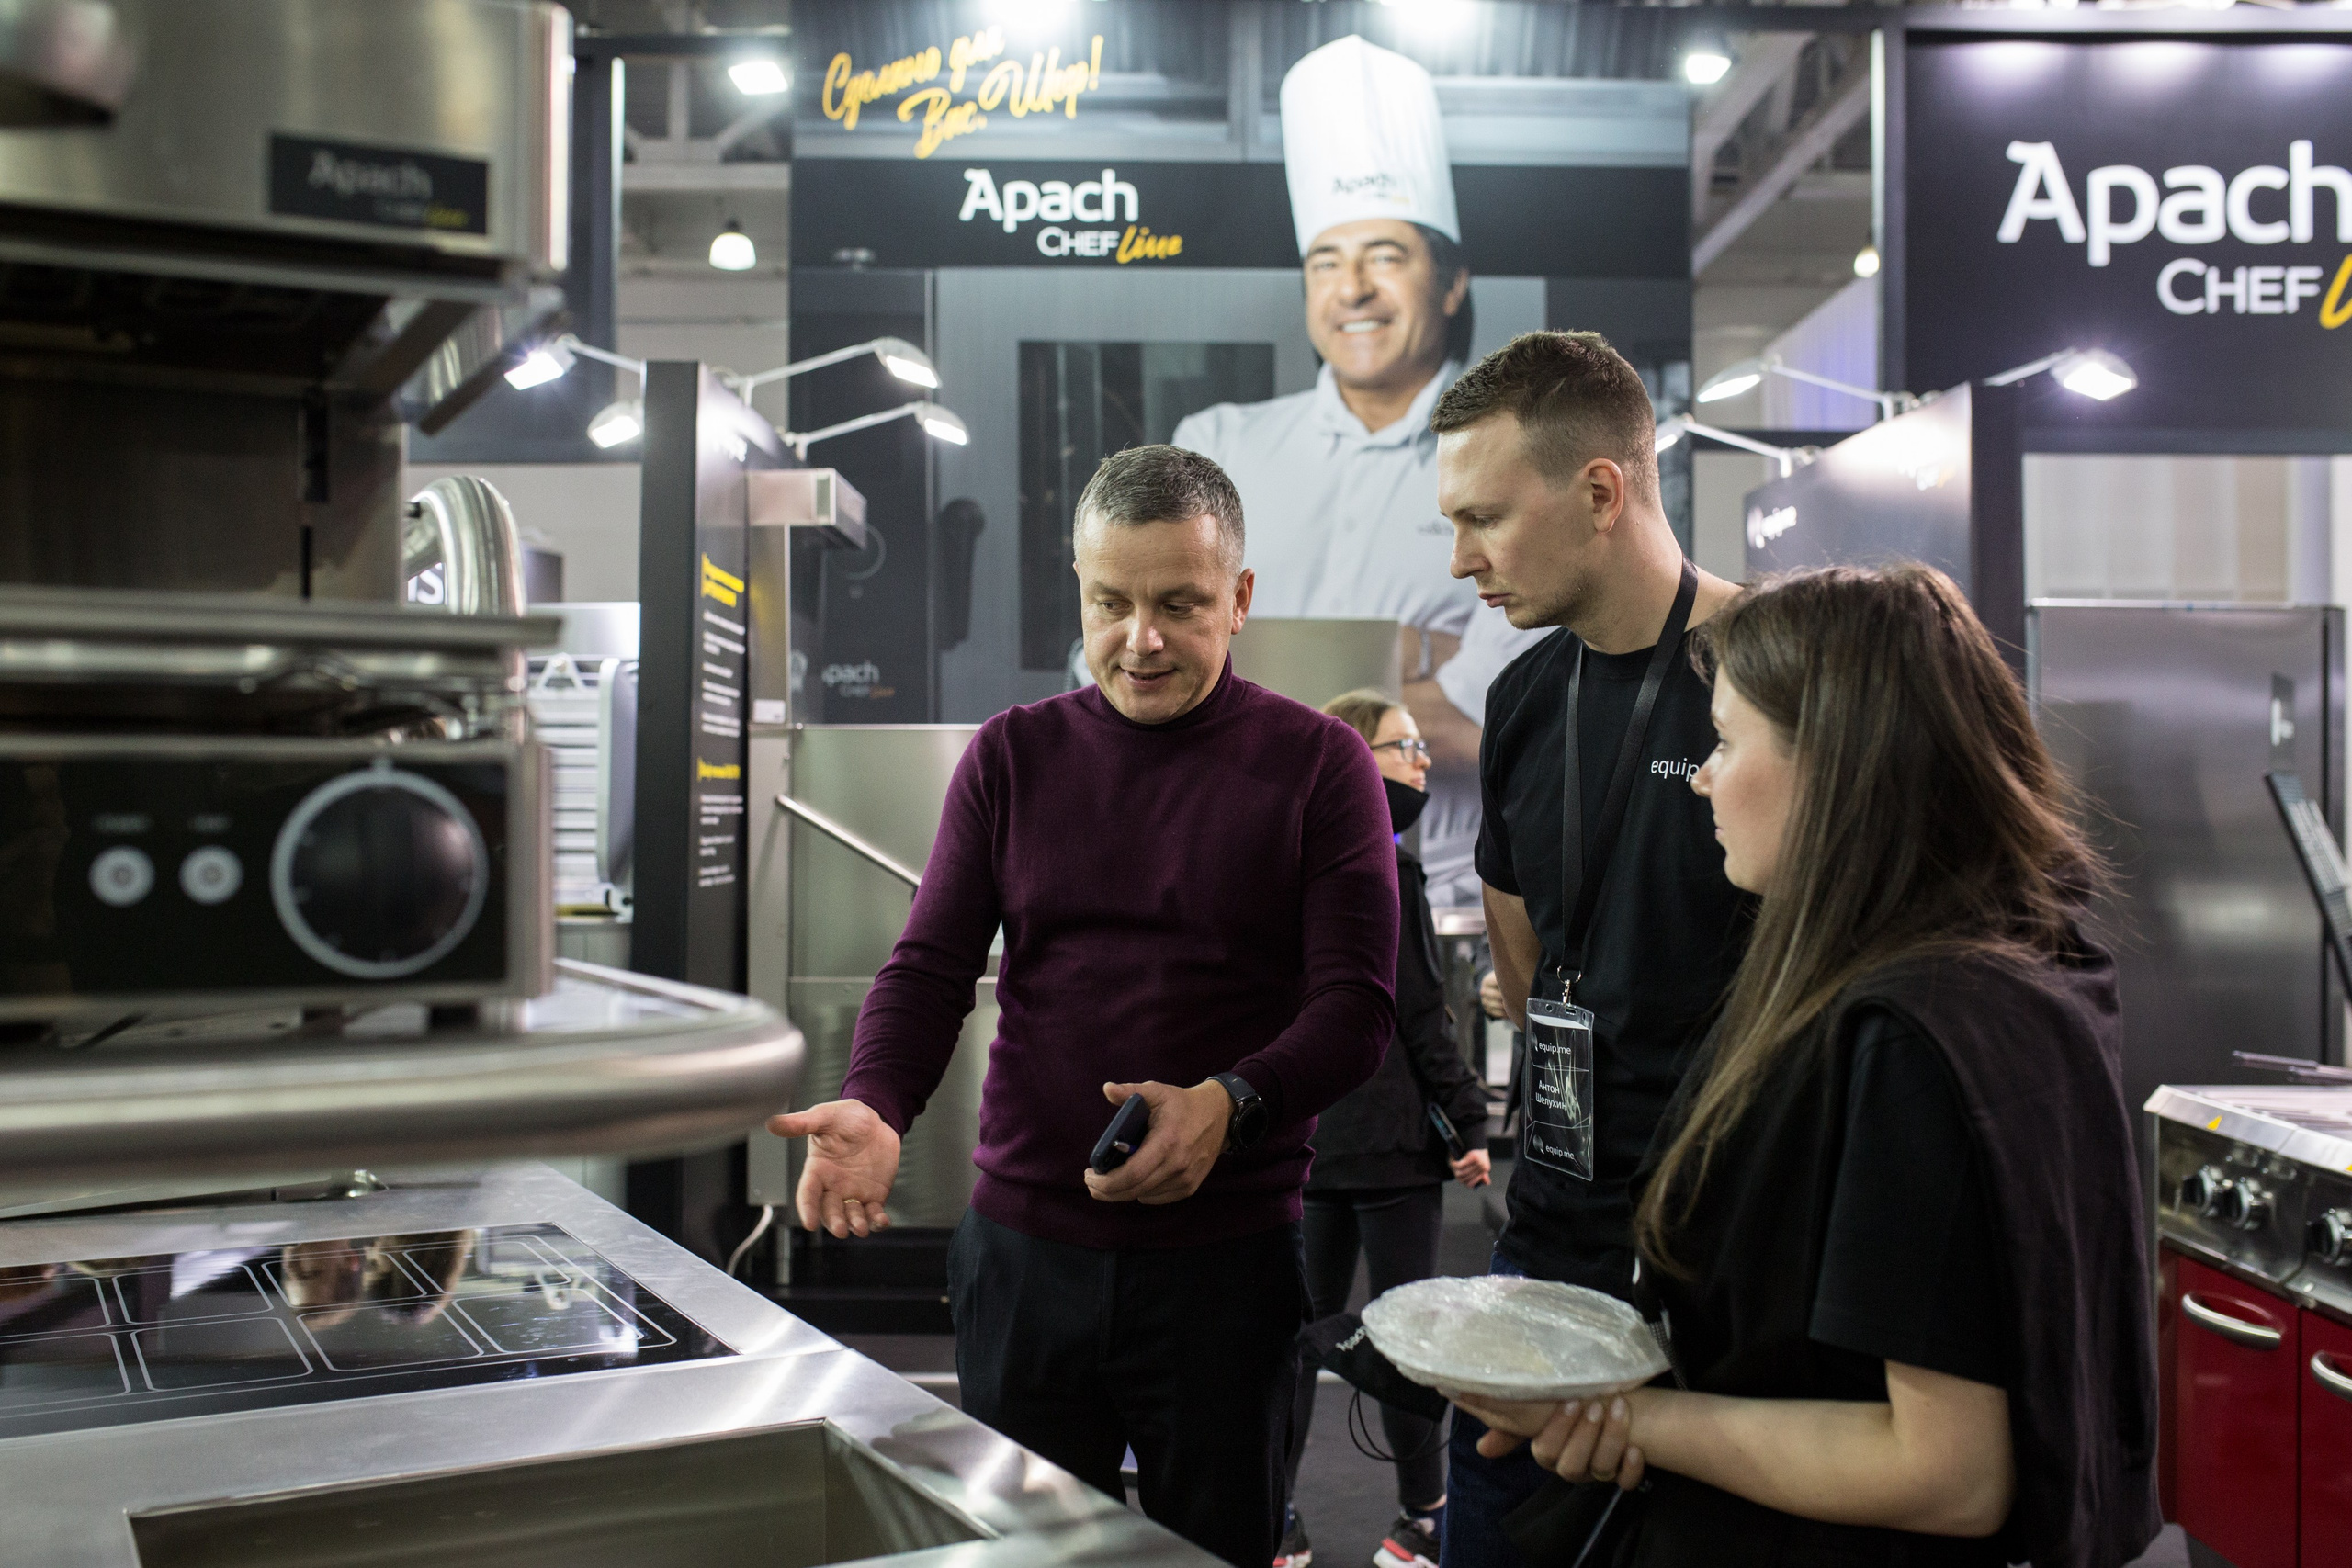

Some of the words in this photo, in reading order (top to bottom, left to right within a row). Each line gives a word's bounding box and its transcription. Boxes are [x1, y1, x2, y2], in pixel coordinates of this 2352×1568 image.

[958, 168, 1139, 233] Apach
[1996, 140, 2352, 267] Apach
[1036, 226, 1120, 257] CHEF
[2156, 257, 2324, 315] CHEF
[1650, 757, 1700, 783] equip
[1538, 1043, 1572, 1055] equip.me
[1538, 1079, 1560, 1095] Антон
[1535, 1091, 1567, 1111] Шелухин
[1545, 1145, 1575, 1160] equip.me
